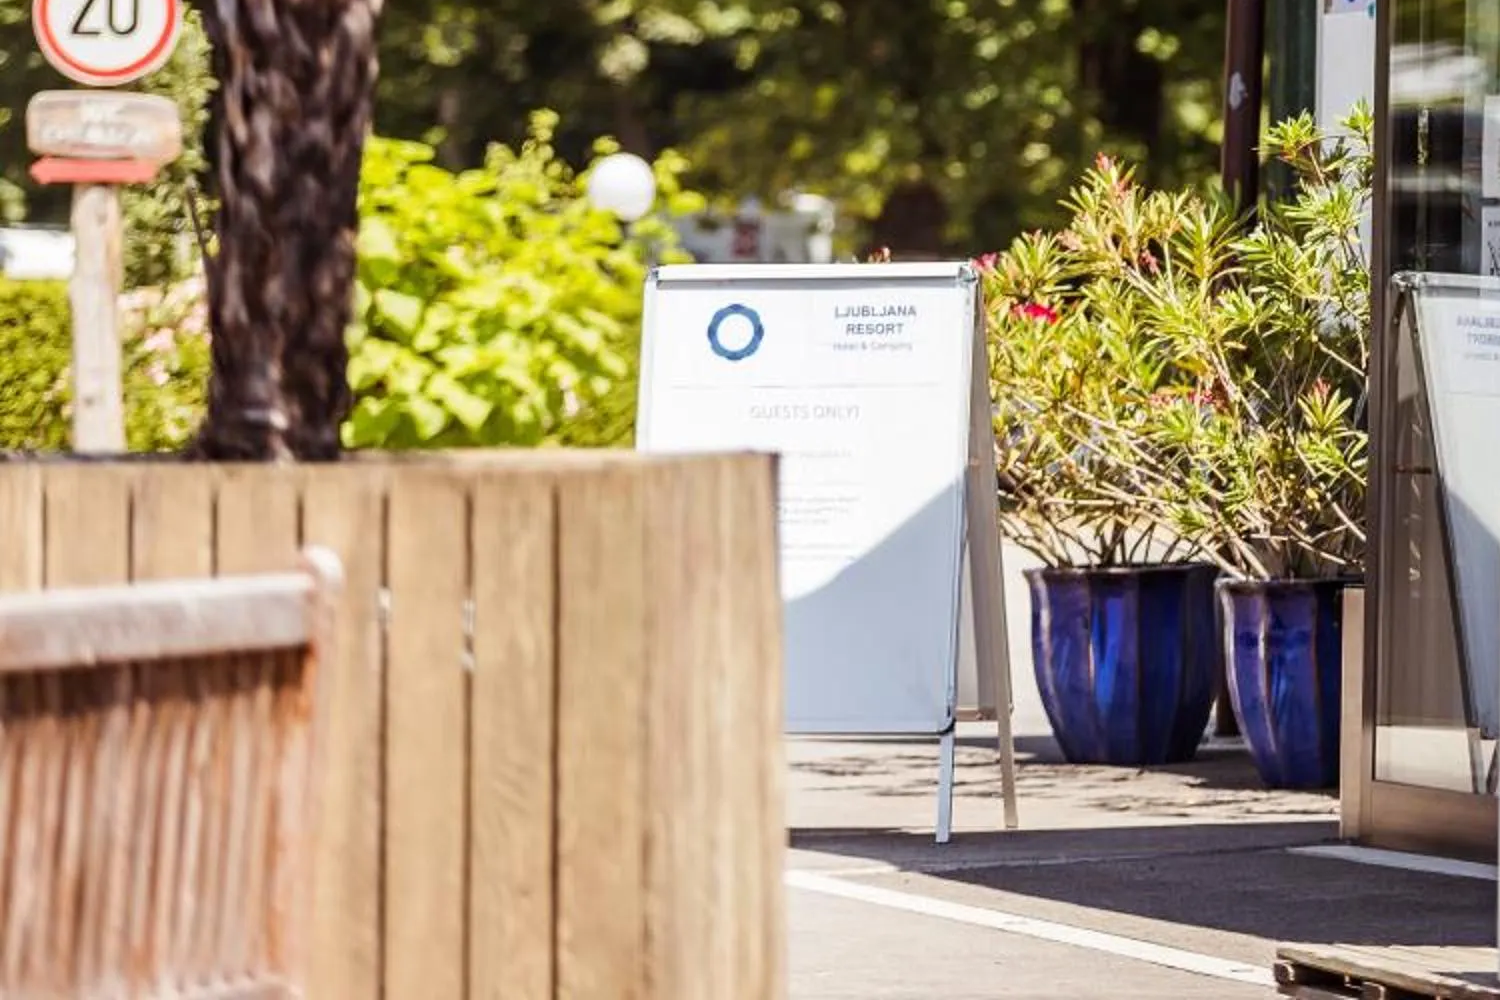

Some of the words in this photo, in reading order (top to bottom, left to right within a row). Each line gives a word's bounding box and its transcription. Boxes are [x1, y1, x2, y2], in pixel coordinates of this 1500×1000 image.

[834, 304, 918, 319] LJUBLJANA
[846, 322, 905, 336] RESORT
[749, 404, 810, 420] GUESTS
